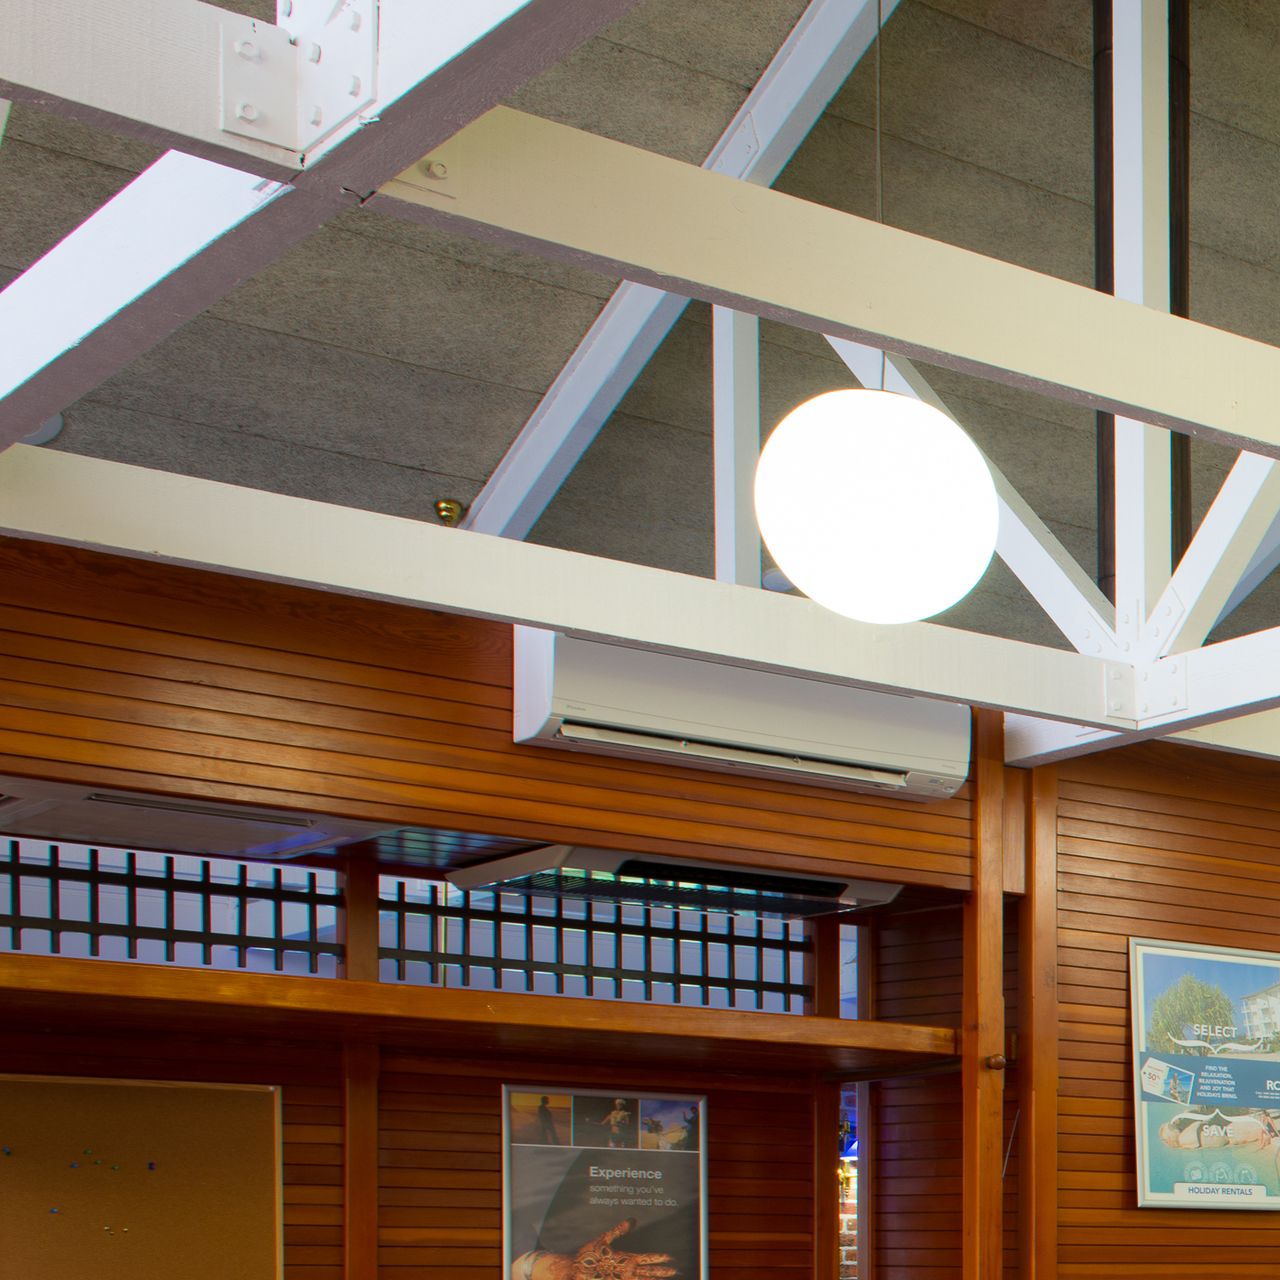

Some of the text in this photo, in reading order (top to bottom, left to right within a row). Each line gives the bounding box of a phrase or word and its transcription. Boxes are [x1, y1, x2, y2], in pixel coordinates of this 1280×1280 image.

[1193, 1024, 1237, 1038] SELECT
[1199, 1078, 1236, 1086] REJUVENATION
[1202, 1124, 1234, 1137] SAVE
[589, 1166, 663, 1180] Experience
[589, 1185, 664, 1195] something you've
[1188, 1186, 1253, 1196] HOLIDAY RENTALS
[589, 1197, 680, 1207] always wanted to do.
